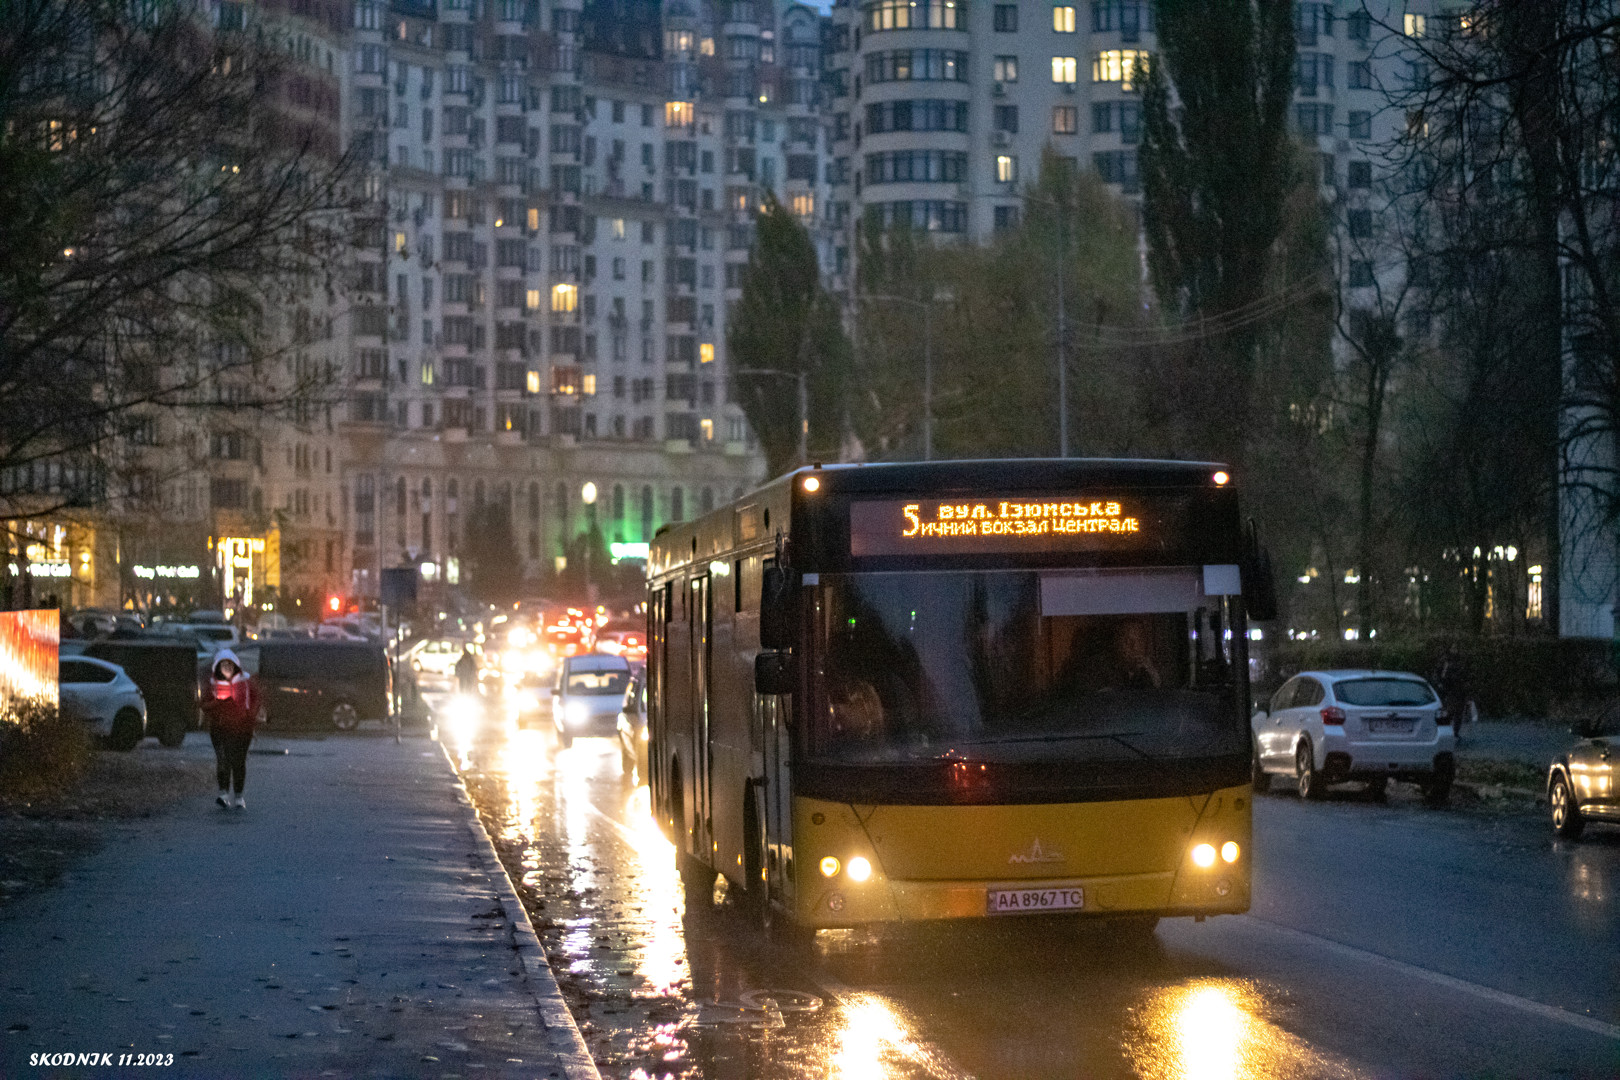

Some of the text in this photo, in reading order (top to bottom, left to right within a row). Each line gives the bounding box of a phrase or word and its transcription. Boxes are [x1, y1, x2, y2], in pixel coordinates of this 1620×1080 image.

[939, 501, 1121, 519] вул. Ізюмська
[903, 504, 919, 536] 5
[921, 521, 977, 536] ичний
[999, 893, 1020, 908] AA
[1022, 892, 1057, 907] 8967
